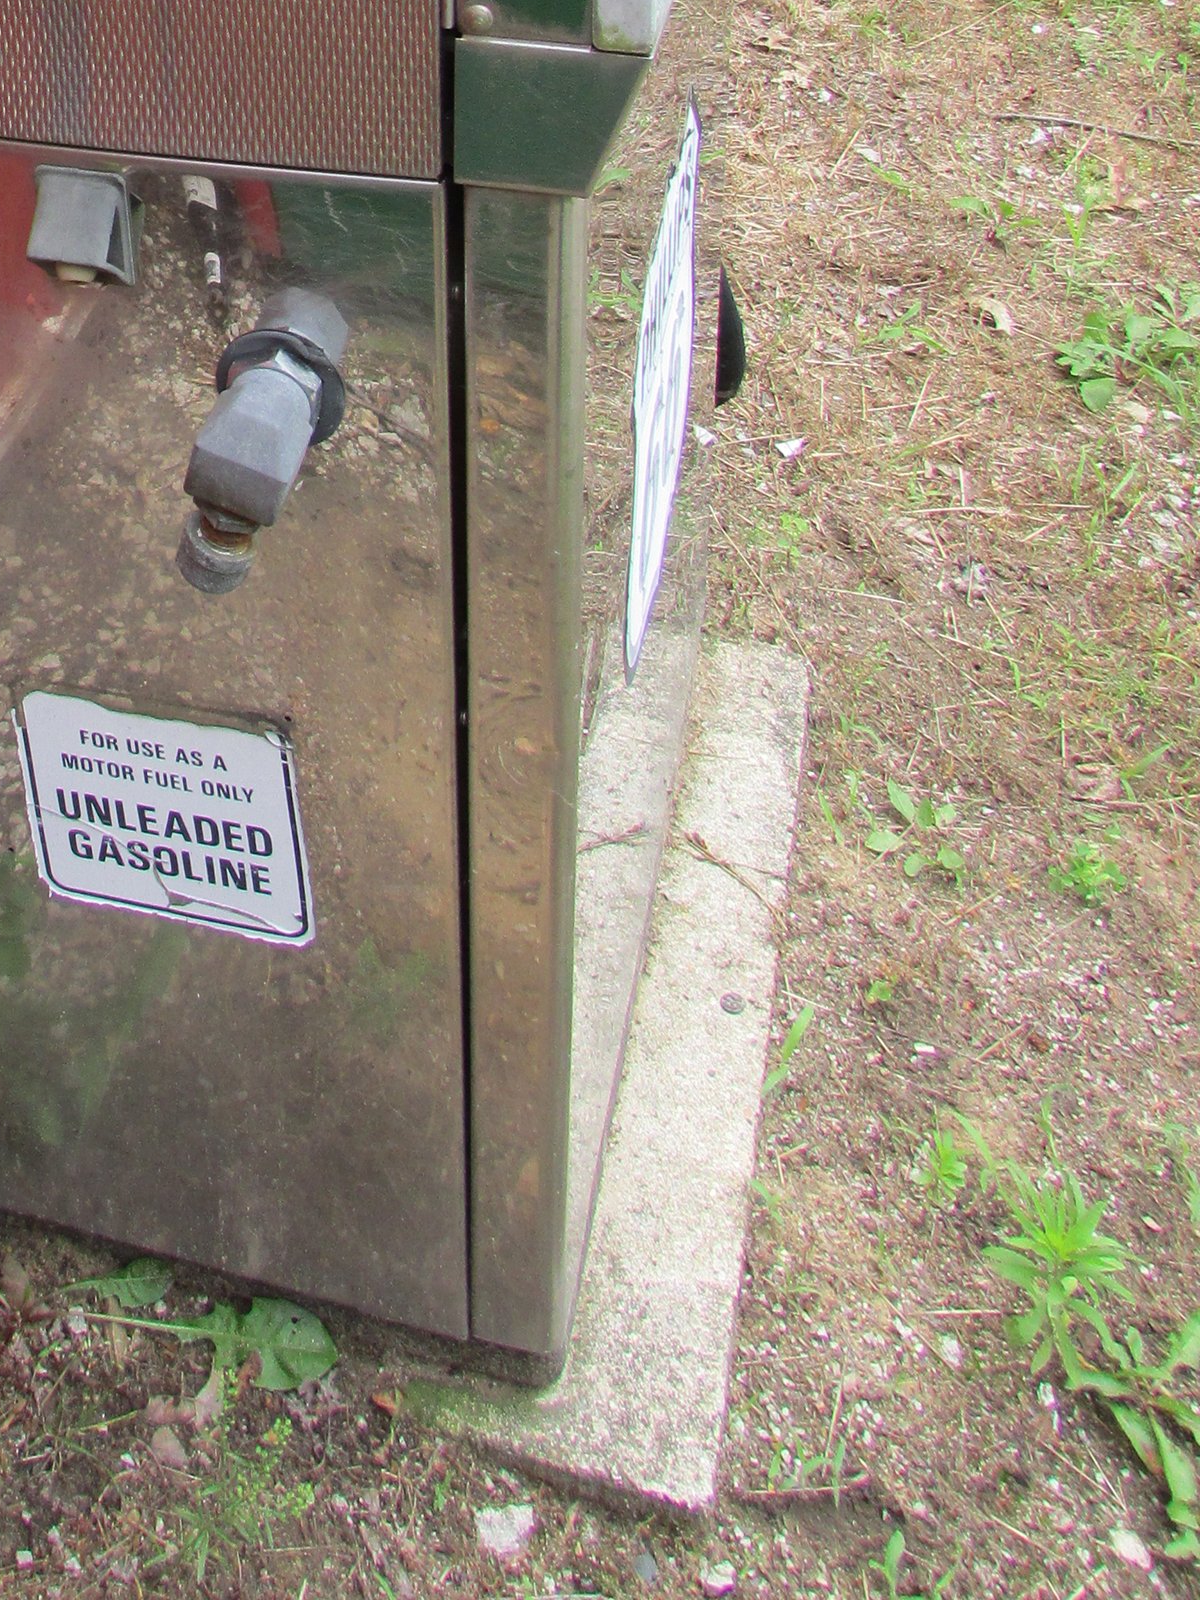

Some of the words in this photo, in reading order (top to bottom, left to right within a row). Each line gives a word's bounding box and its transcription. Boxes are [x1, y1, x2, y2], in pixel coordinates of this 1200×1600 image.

[60, 752, 135, 782] MOTOR
[143, 768, 193, 793] FUEL
[201, 779, 255, 804] ONLY
[79, 729, 119, 752] FOR
[126, 738, 166, 760] USE
[175, 748, 203, 767] AS
[213, 754, 228, 772] A
[56, 787, 274, 857] UNLEADED
[67, 828, 273, 896] GASOLINE
